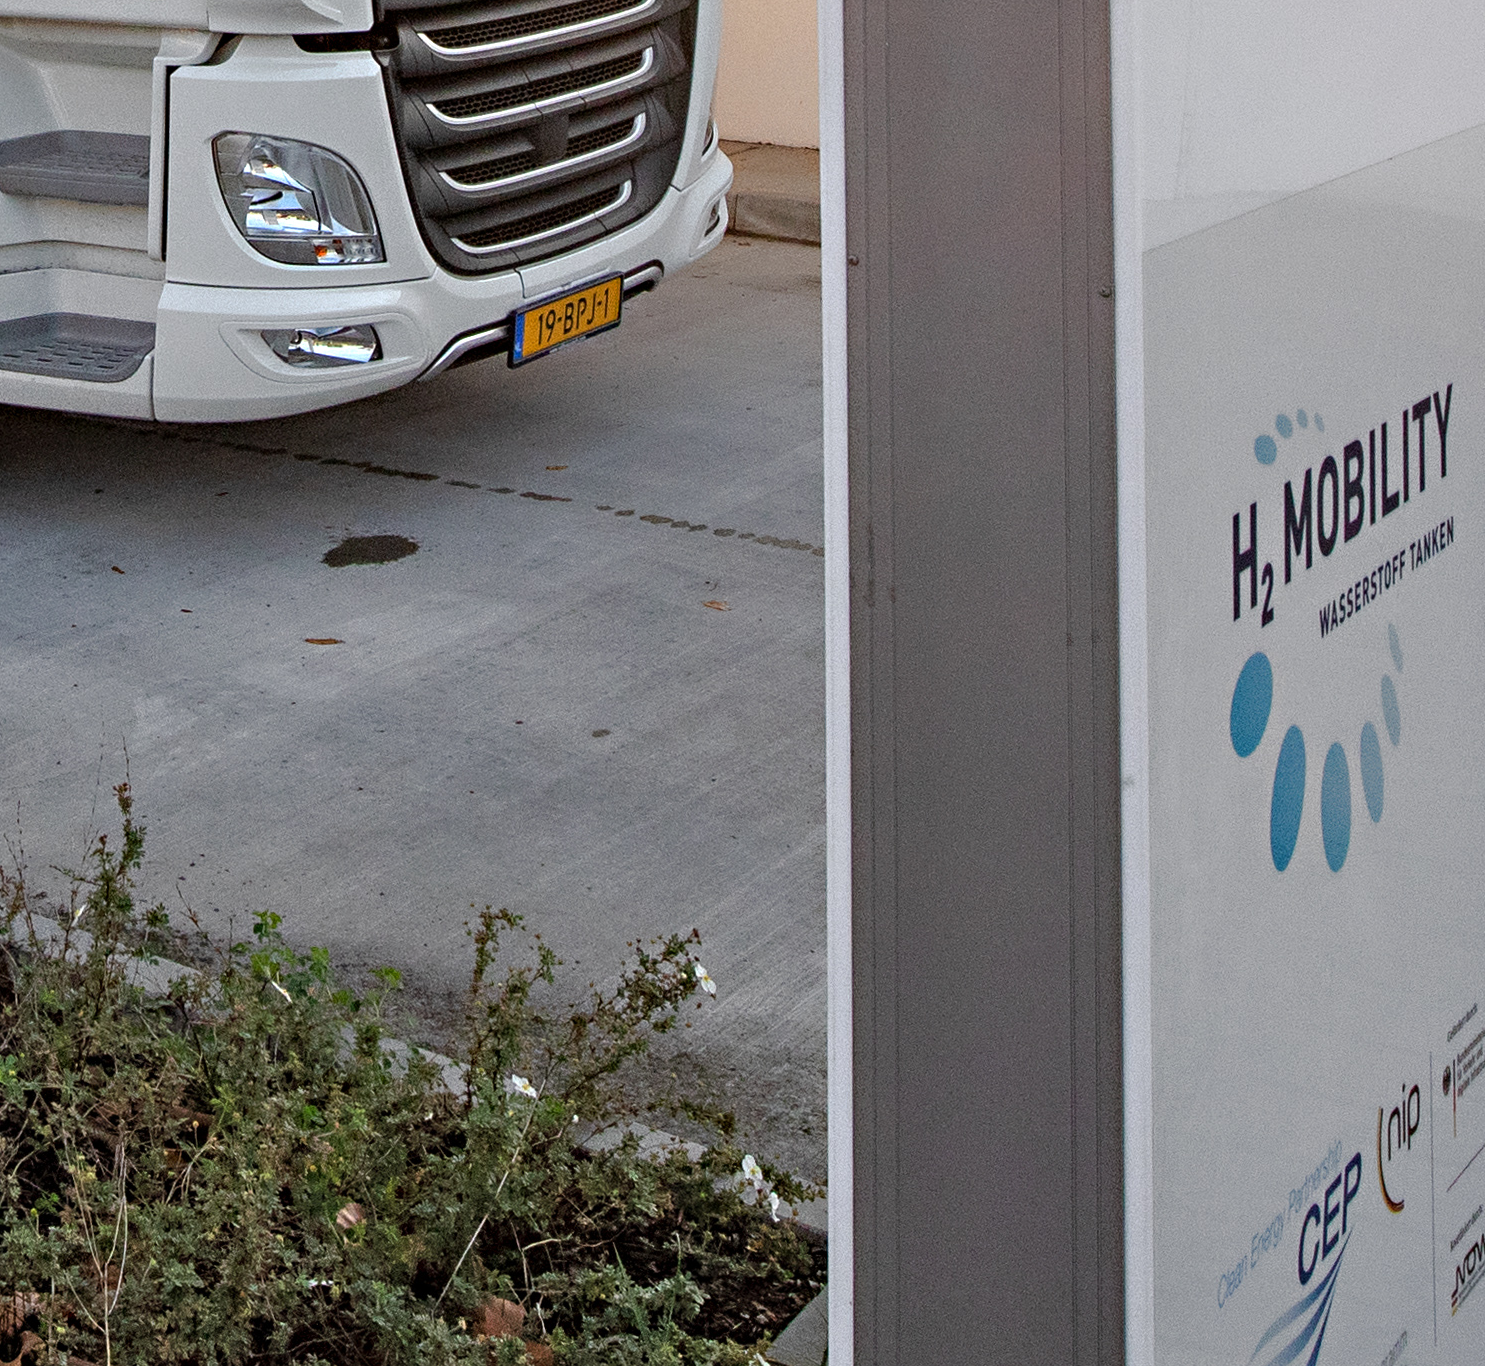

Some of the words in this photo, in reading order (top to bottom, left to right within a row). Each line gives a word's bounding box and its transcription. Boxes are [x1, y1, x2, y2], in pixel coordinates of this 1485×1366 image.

[537, 287, 610, 346] 19-BPJ-1
[1283, 382, 1454, 585] MOBILITY
[1319, 548, 1406, 639] WASSERSTOFF
[1410, 515, 1454, 572] TANKEN
[1298, 1151, 1362, 1286] CEP
